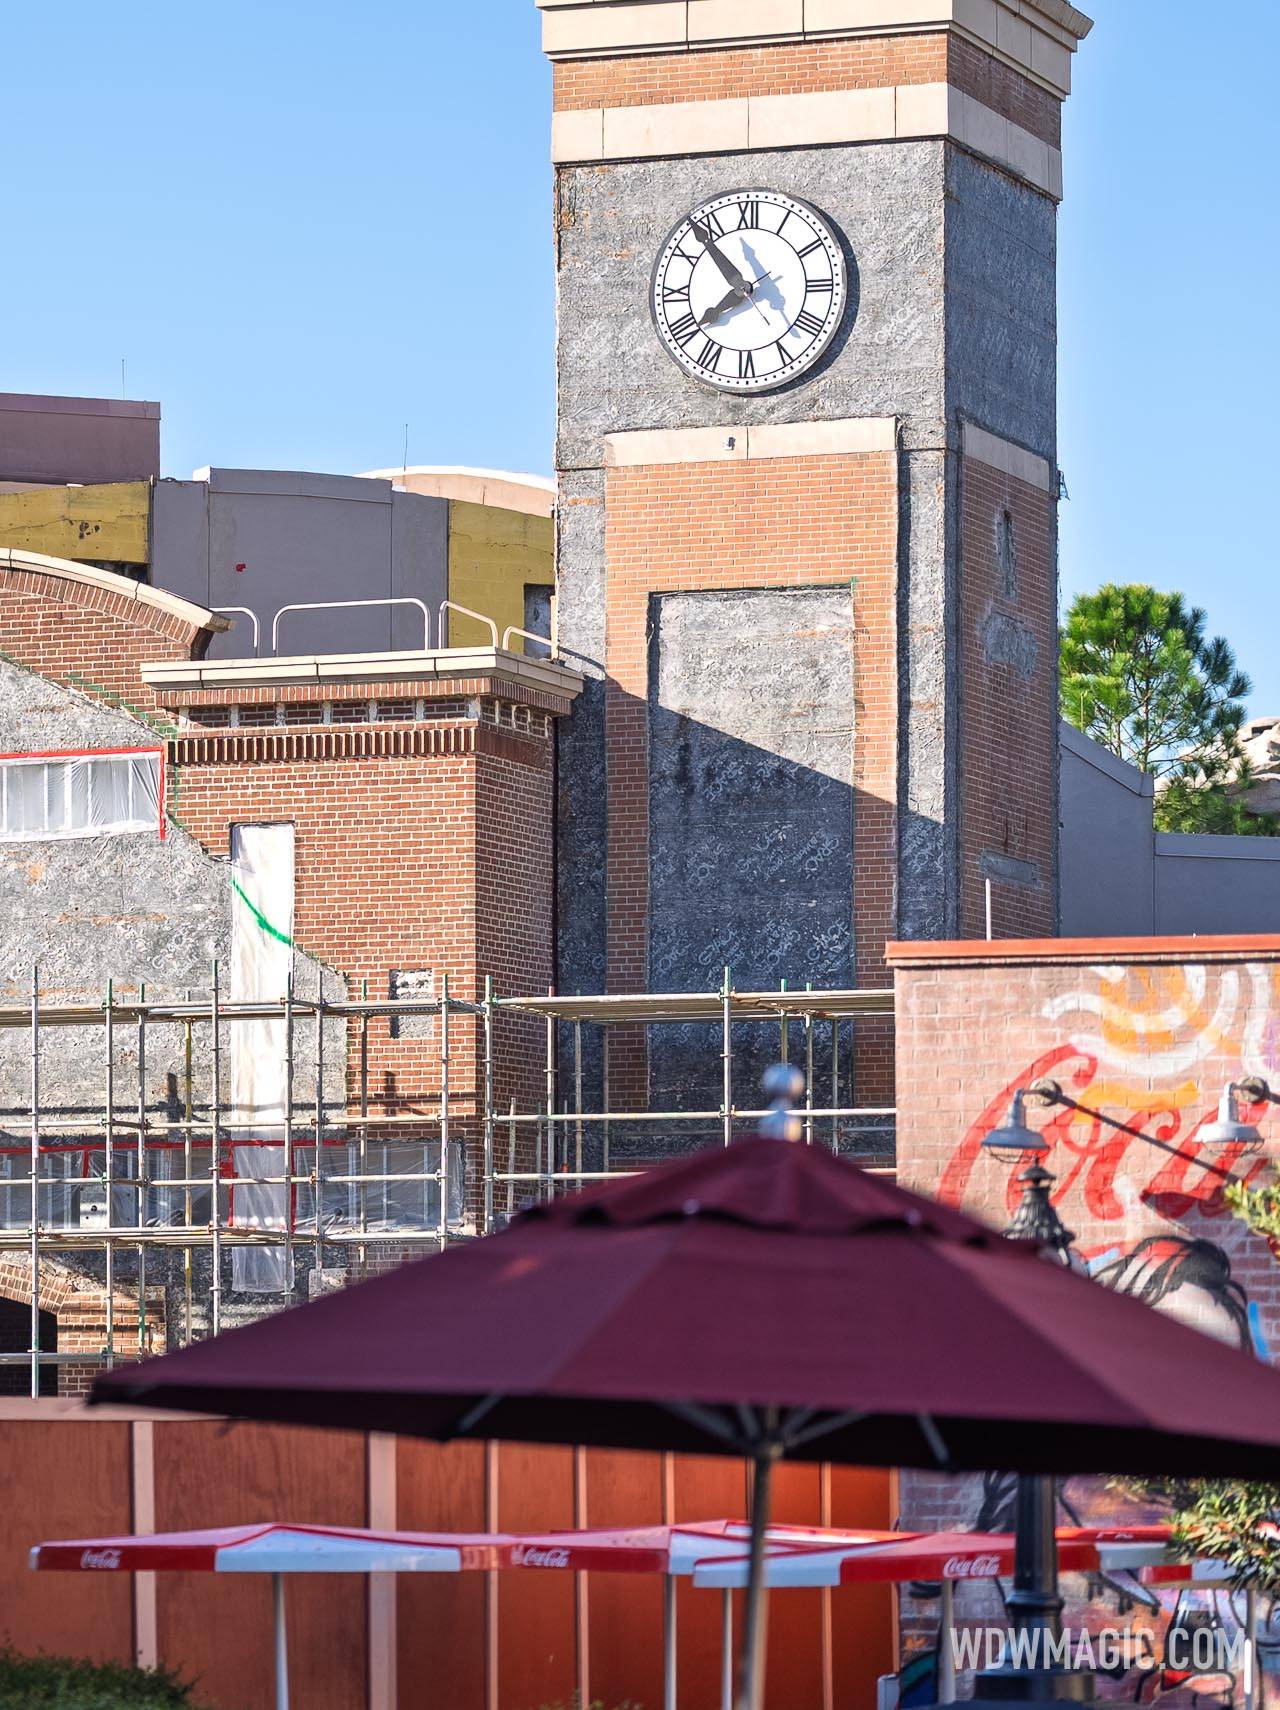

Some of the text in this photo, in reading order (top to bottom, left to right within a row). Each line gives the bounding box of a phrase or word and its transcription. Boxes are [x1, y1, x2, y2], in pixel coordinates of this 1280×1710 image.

[698, 211, 725, 241] XI
[737, 201, 759, 229] XII
[777, 210, 791, 235] I
[672, 246, 699, 266] X
[798, 238, 823, 258] II
[663, 285, 689, 303] IX
[806, 279, 833, 292] III
[670, 312, 700, 348] VIII
[697, 338, 722, 373] VII
[738, 350, 755, 378] VI
[776, 341, 794, 366] V
